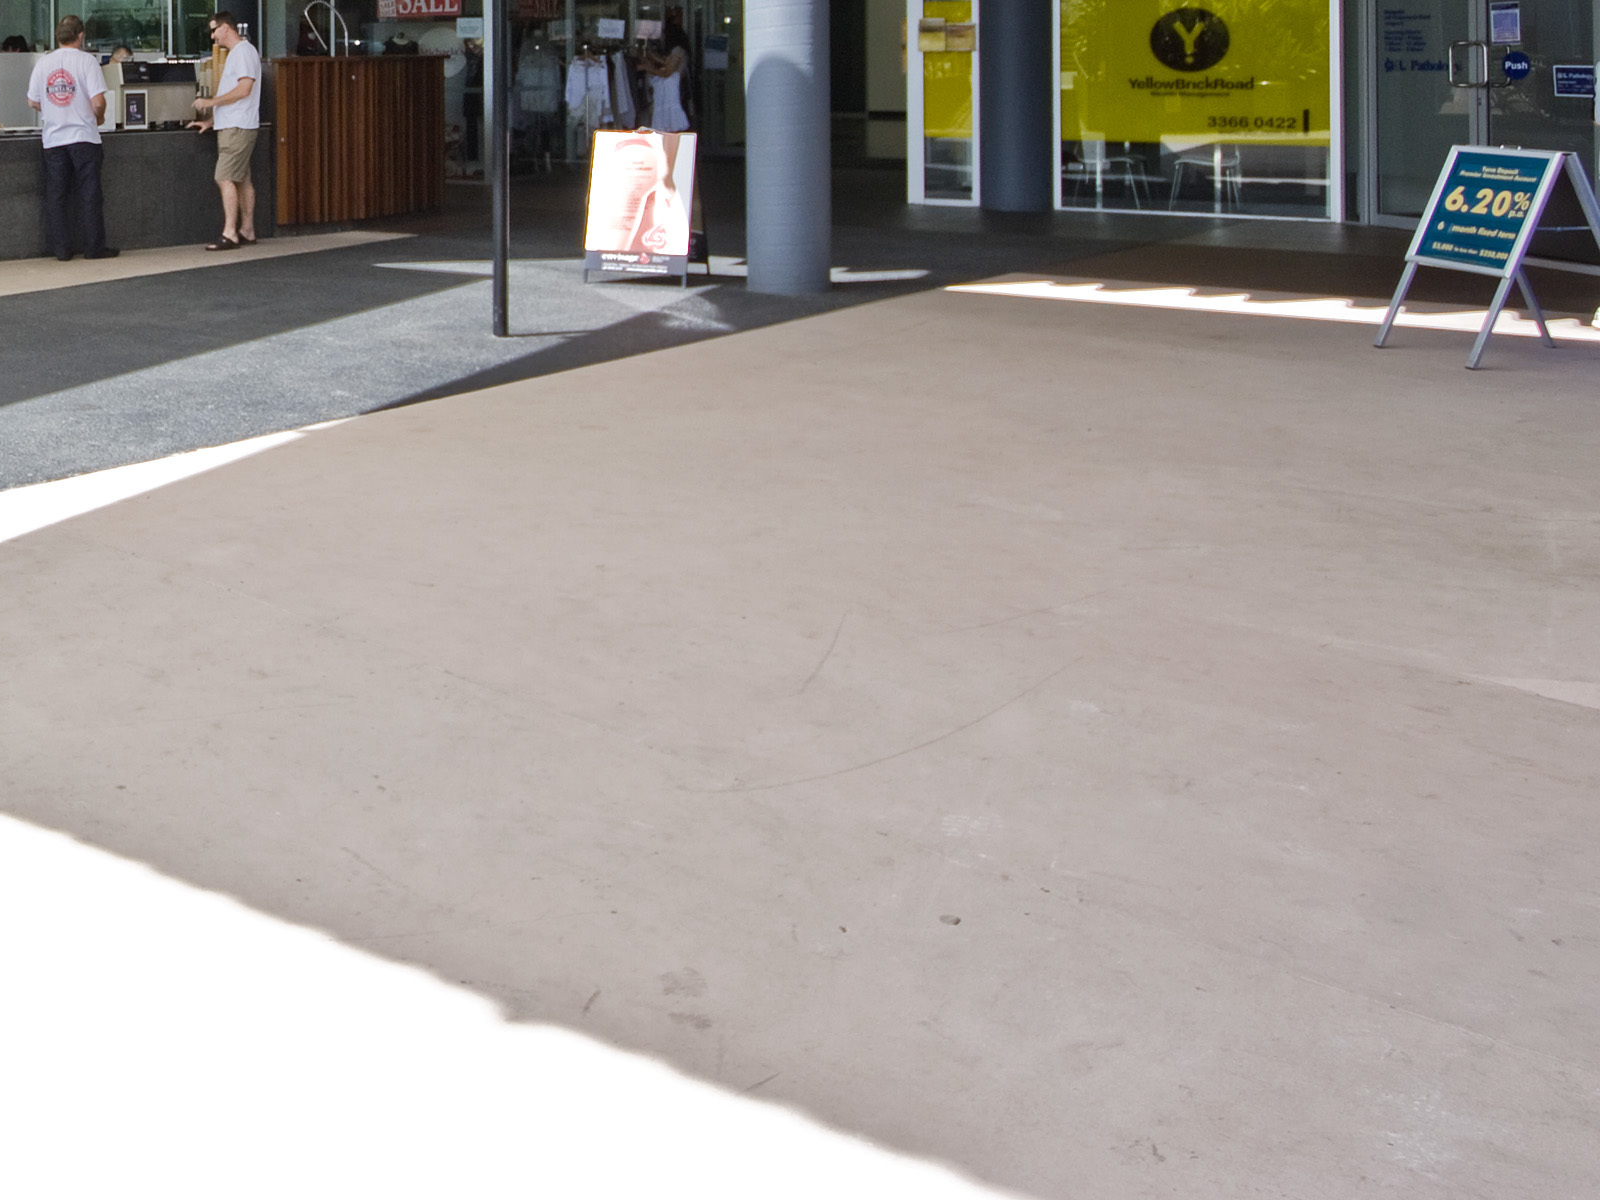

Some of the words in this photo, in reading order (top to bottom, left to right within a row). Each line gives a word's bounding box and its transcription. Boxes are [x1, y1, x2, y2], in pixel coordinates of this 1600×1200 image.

[1504, 61, 1529, 70] Push
[1128, 76, 1255, 91] YellowBrickRoad
[1207, 115, 1250, 128] 3366
[1253, 115, 1297, 129] 0422
[1437, 220, 1445, 231] 6
[1451, 224, 1477, 234] month
